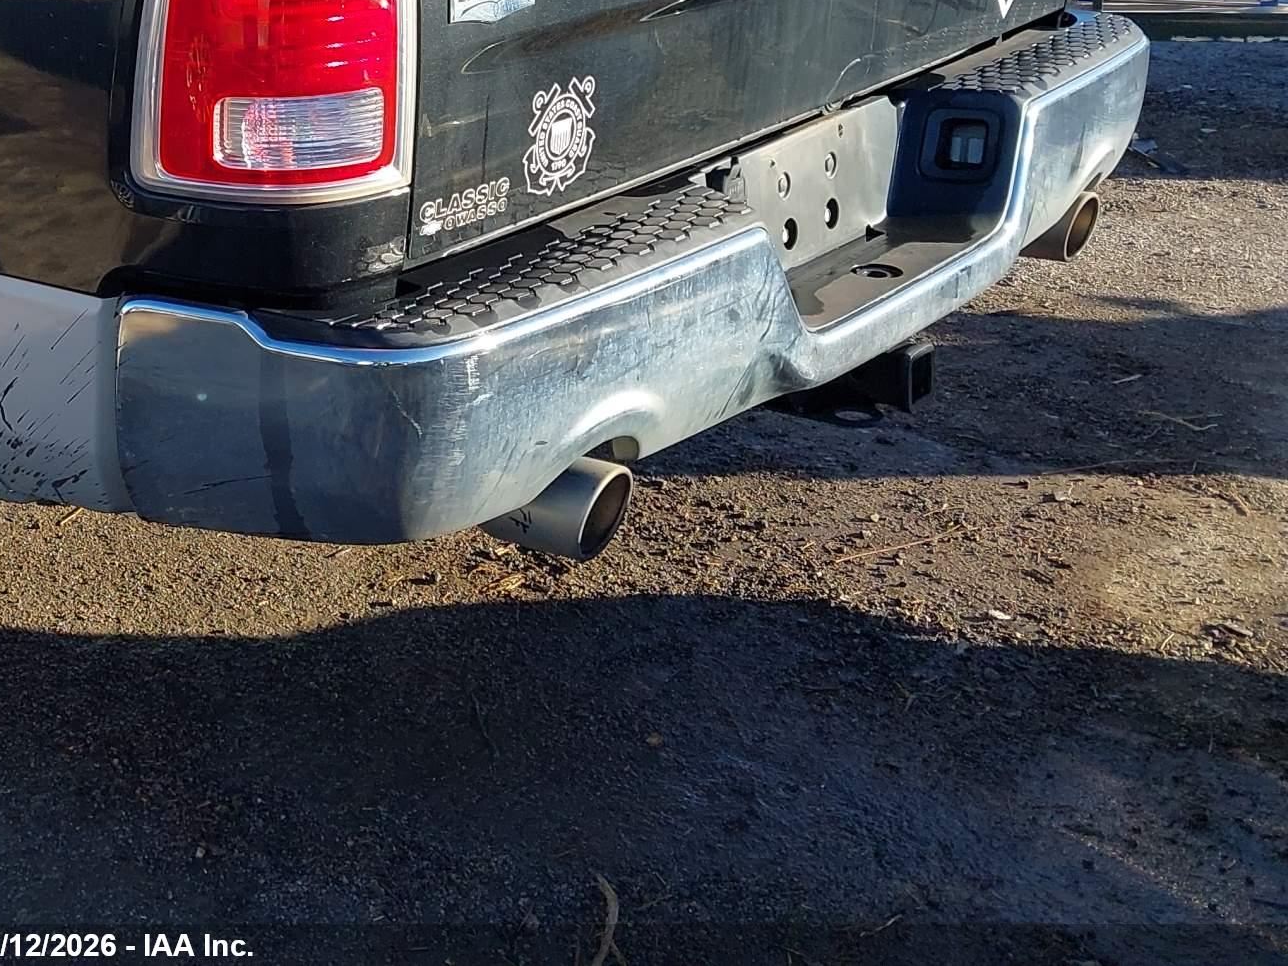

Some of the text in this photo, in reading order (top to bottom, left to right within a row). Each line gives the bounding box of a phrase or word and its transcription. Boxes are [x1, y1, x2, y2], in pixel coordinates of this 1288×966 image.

[542, 99, 565, 130] STATES
[565, 98, 582, 121] COAST
[568, 120, 583, 159] GUARD
[551, 158, 567, 172] 1790
[420, 177, 510, 223] CLASSIC
[444, 197, 508, 231] OWASSO
